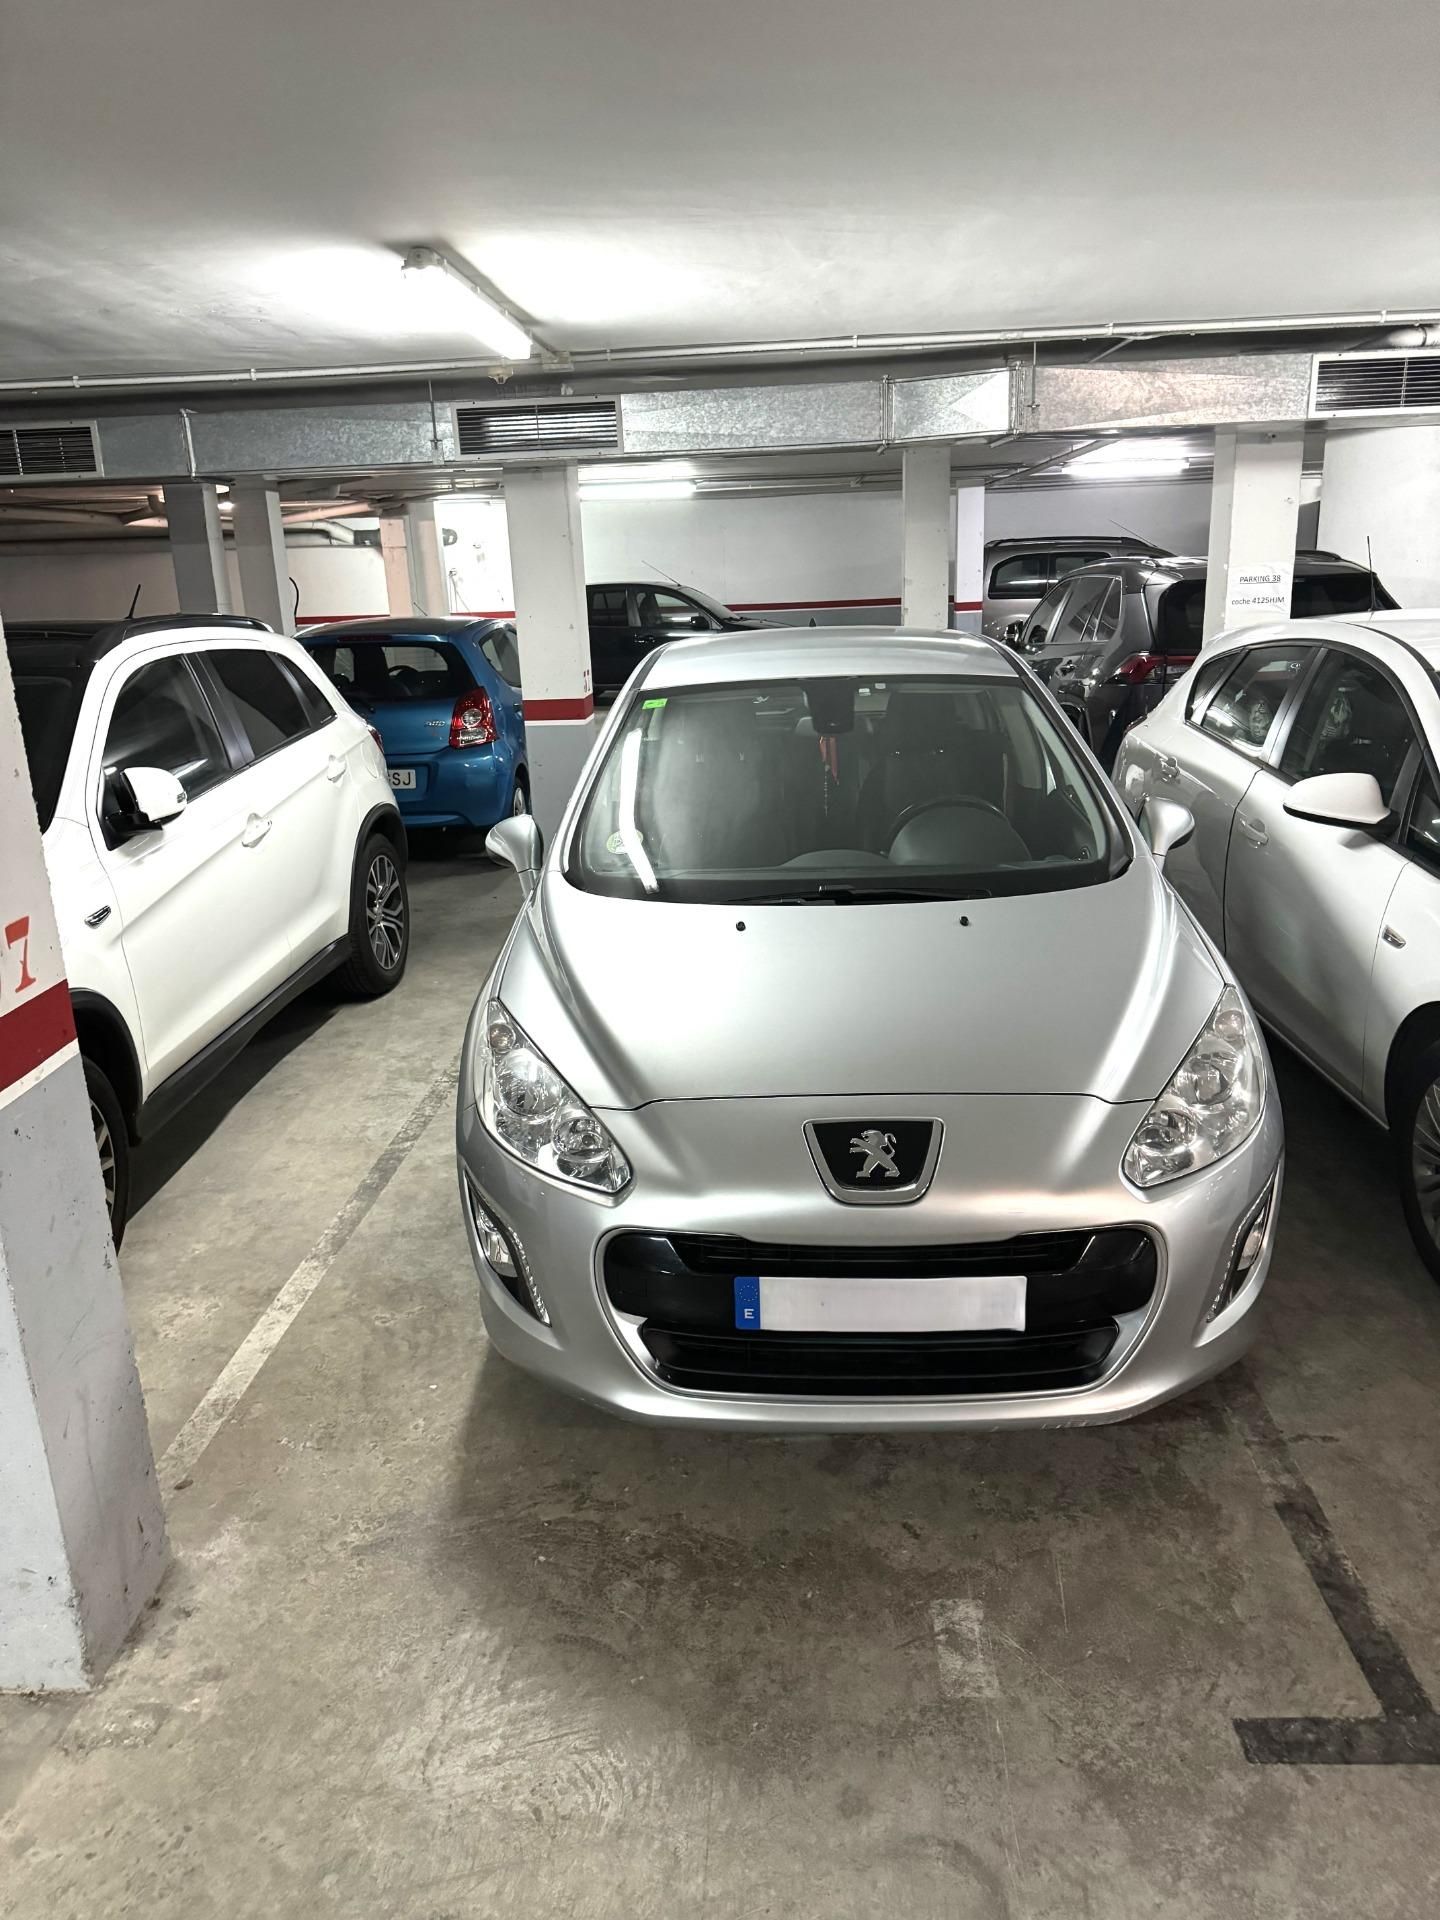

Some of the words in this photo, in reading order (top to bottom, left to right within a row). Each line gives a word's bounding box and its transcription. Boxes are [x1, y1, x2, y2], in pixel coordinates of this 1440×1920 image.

[1239, 575, 1270, 583] PARKING
[1271, 574, 1282, 582] 38
[1231, 597, 1251, 605] coche
[387, 771, 412, 786] SJ
[0, 915, 37, 993] 7
[744, 1308, 755, 1319] E
